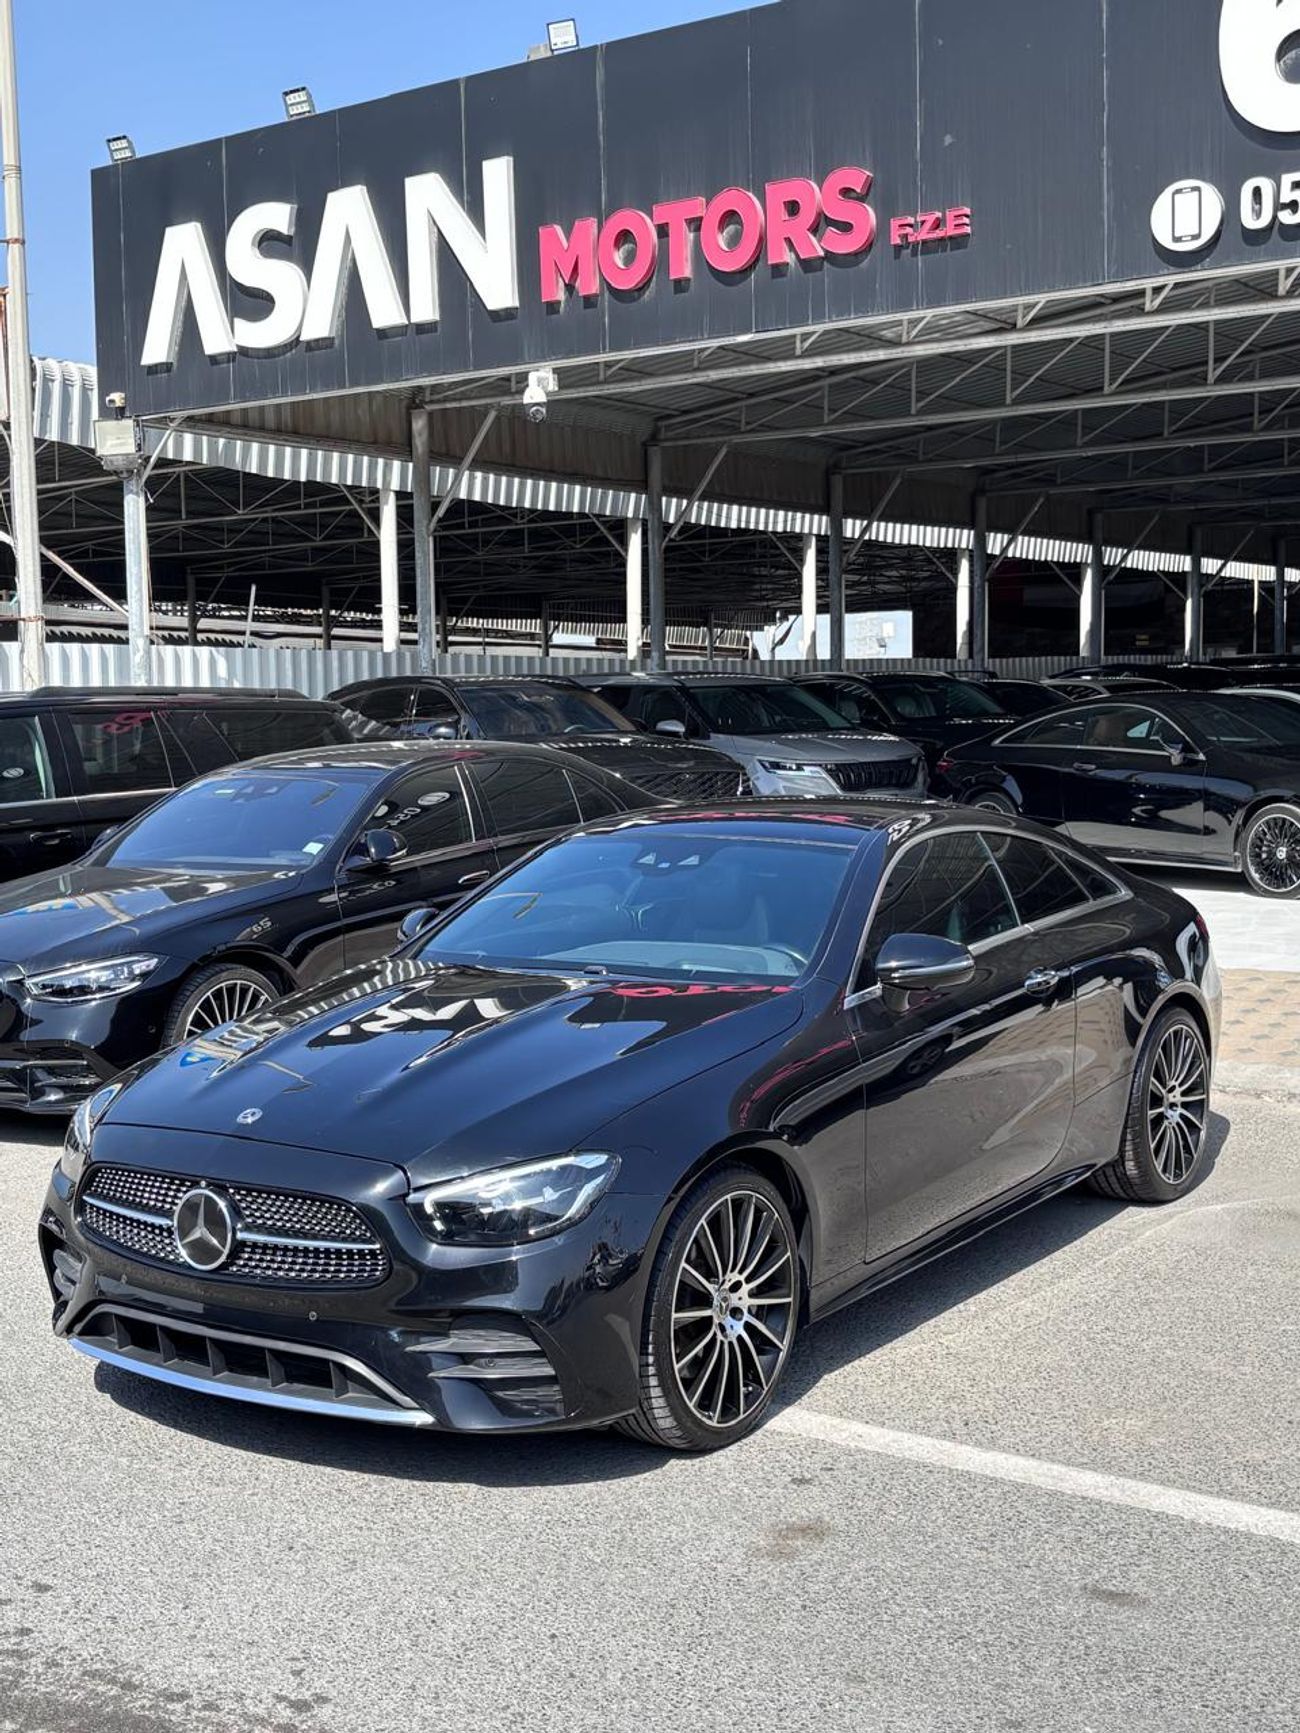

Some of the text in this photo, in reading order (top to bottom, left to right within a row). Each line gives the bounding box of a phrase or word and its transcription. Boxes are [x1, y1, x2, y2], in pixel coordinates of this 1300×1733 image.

[140, 155, 519, 366] ASAN
[539, 166, 876, 303] MOTORS
[1240, 172, 1300, 230] 05
